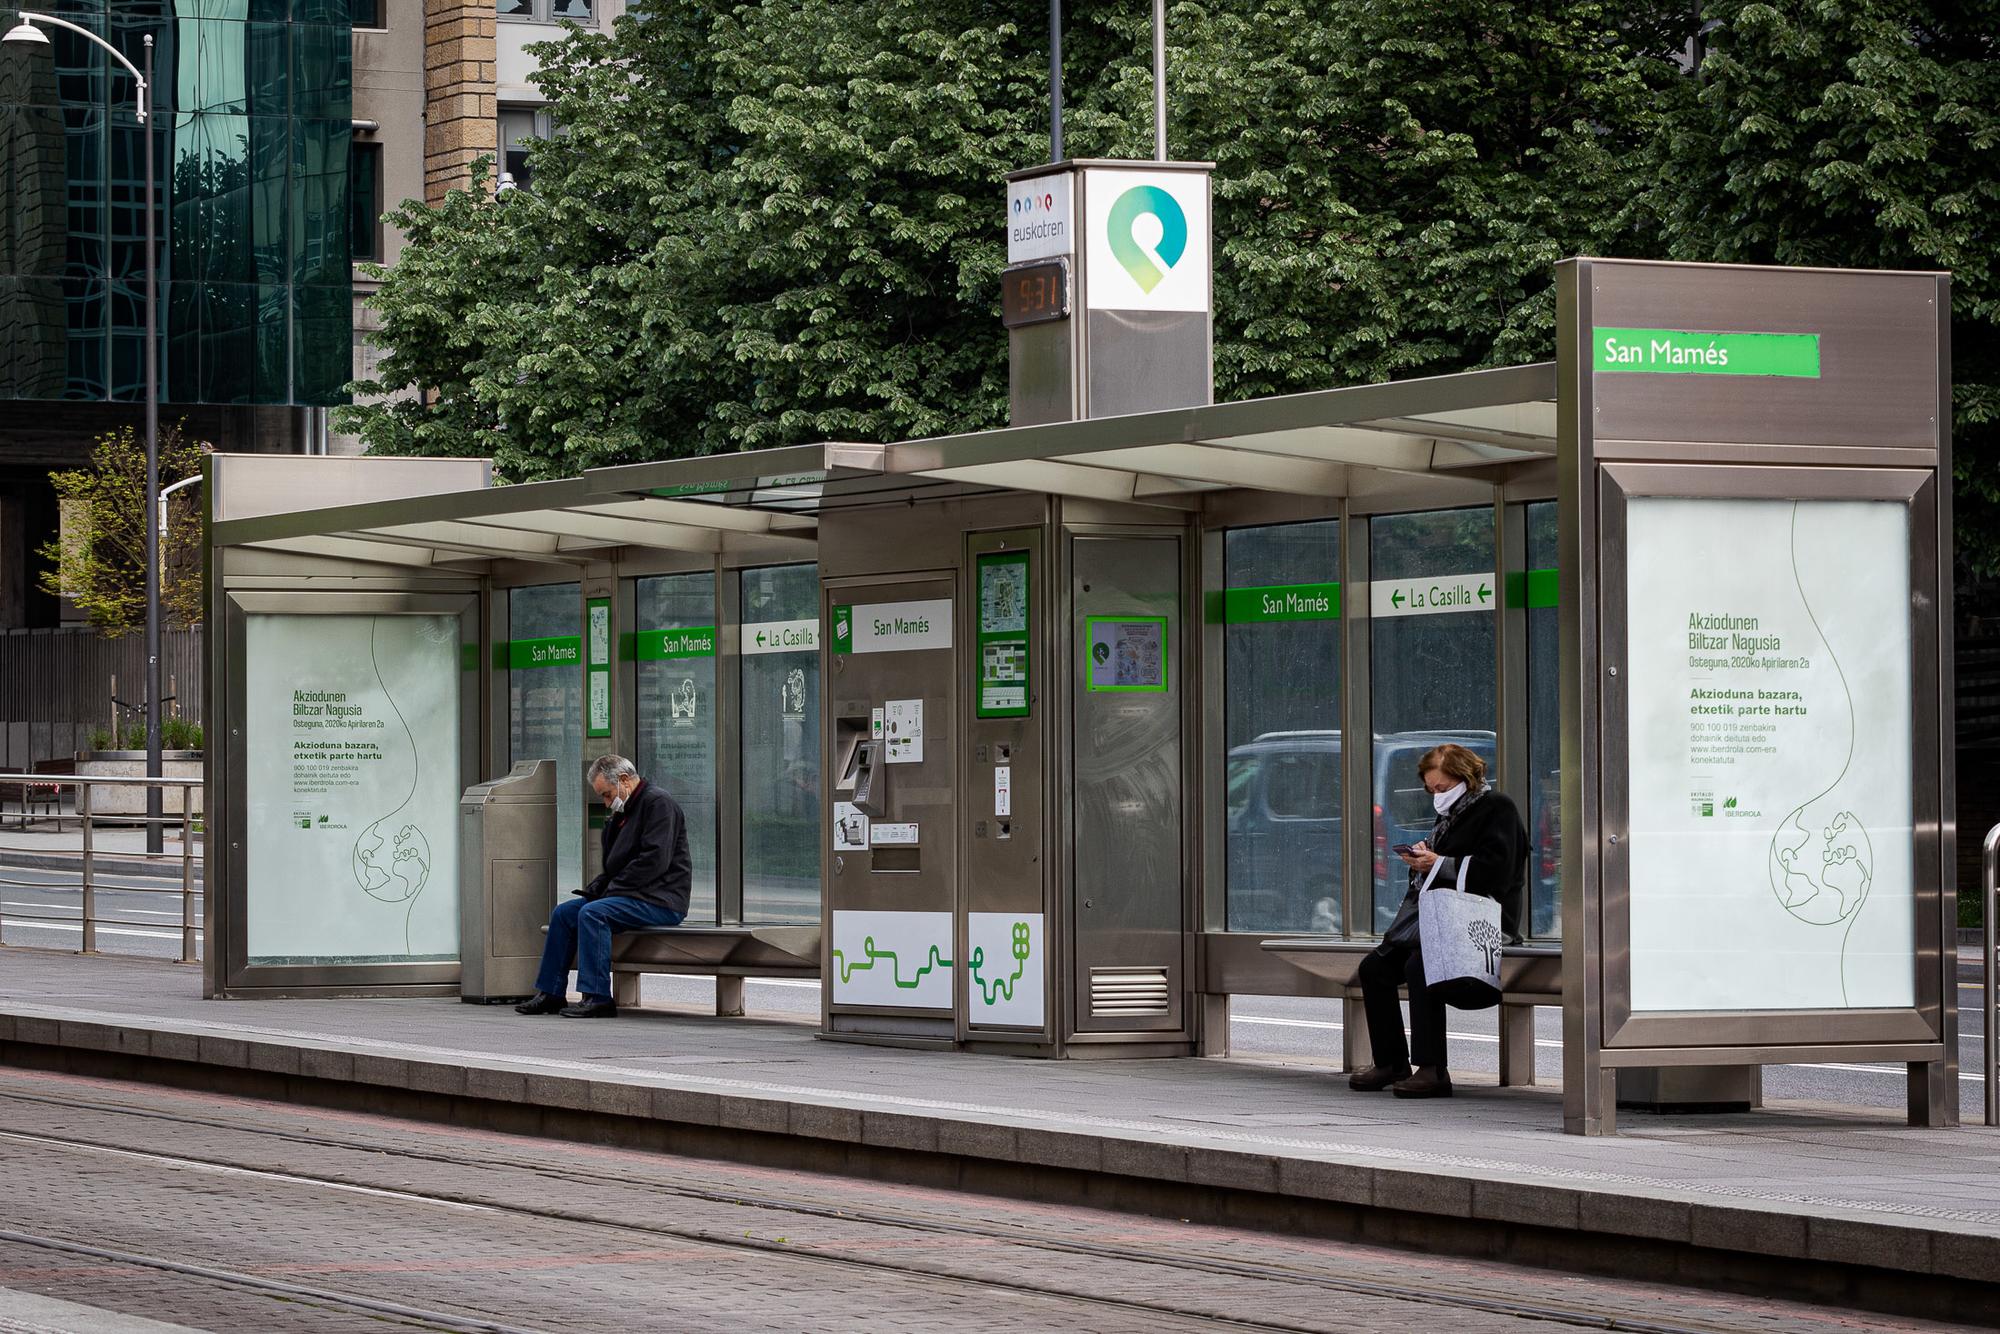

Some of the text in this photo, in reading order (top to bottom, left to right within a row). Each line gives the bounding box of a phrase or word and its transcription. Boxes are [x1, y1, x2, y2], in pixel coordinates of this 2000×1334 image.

[1013, 219, 1064, 242] euskotren
[1605, 337, 1729, 366] San Mamés
[1262, 590, 1330, 614] San Mamés
[1409, 583, 1472, 608] La Casilla
[873, 615, 930, 636] San Mamés
[1689, 612, 1759, 631] Akziodunen
[663, 633, 712, 653] San Mamés
[769, 627, 814, 647] La Casilla
[1689, 633, 1780, 656] Biltzar Nagusia
[532, 643, 577, 661] San Mamés
[1689, 656, 1810, 672] Osteguna, 2020ko Apirilaren 2a
[293, 690, 346, 702] Akziodunen
[1690, 688, 1803, 702] Akzioduna bazara,
[293, 703, 362, 719] Biltzar Nagusia
[1690, 703, 1807, 718] etxetik parte hartu
[293, 719, 385, 730] Osteguna, 2020ko Apirilaren 2a
[1690, 723, 1776, 733] 900 100 019 zenbakira
[294, 741, 379, 751] Akzioduna bazara,
[1690, 734, 1766, 743] dohainik deituta edo
[294, 752, 382, 762] etxetik parte hartu
[1690, 745, 1777, 754] www.iberdrola.com-era
[293, 764, 305, 772] 900
[306, 764, 317, 772] 100
[318, 764, 330, 772] 019
[1690, 755, 1735, 765] konektatuta
